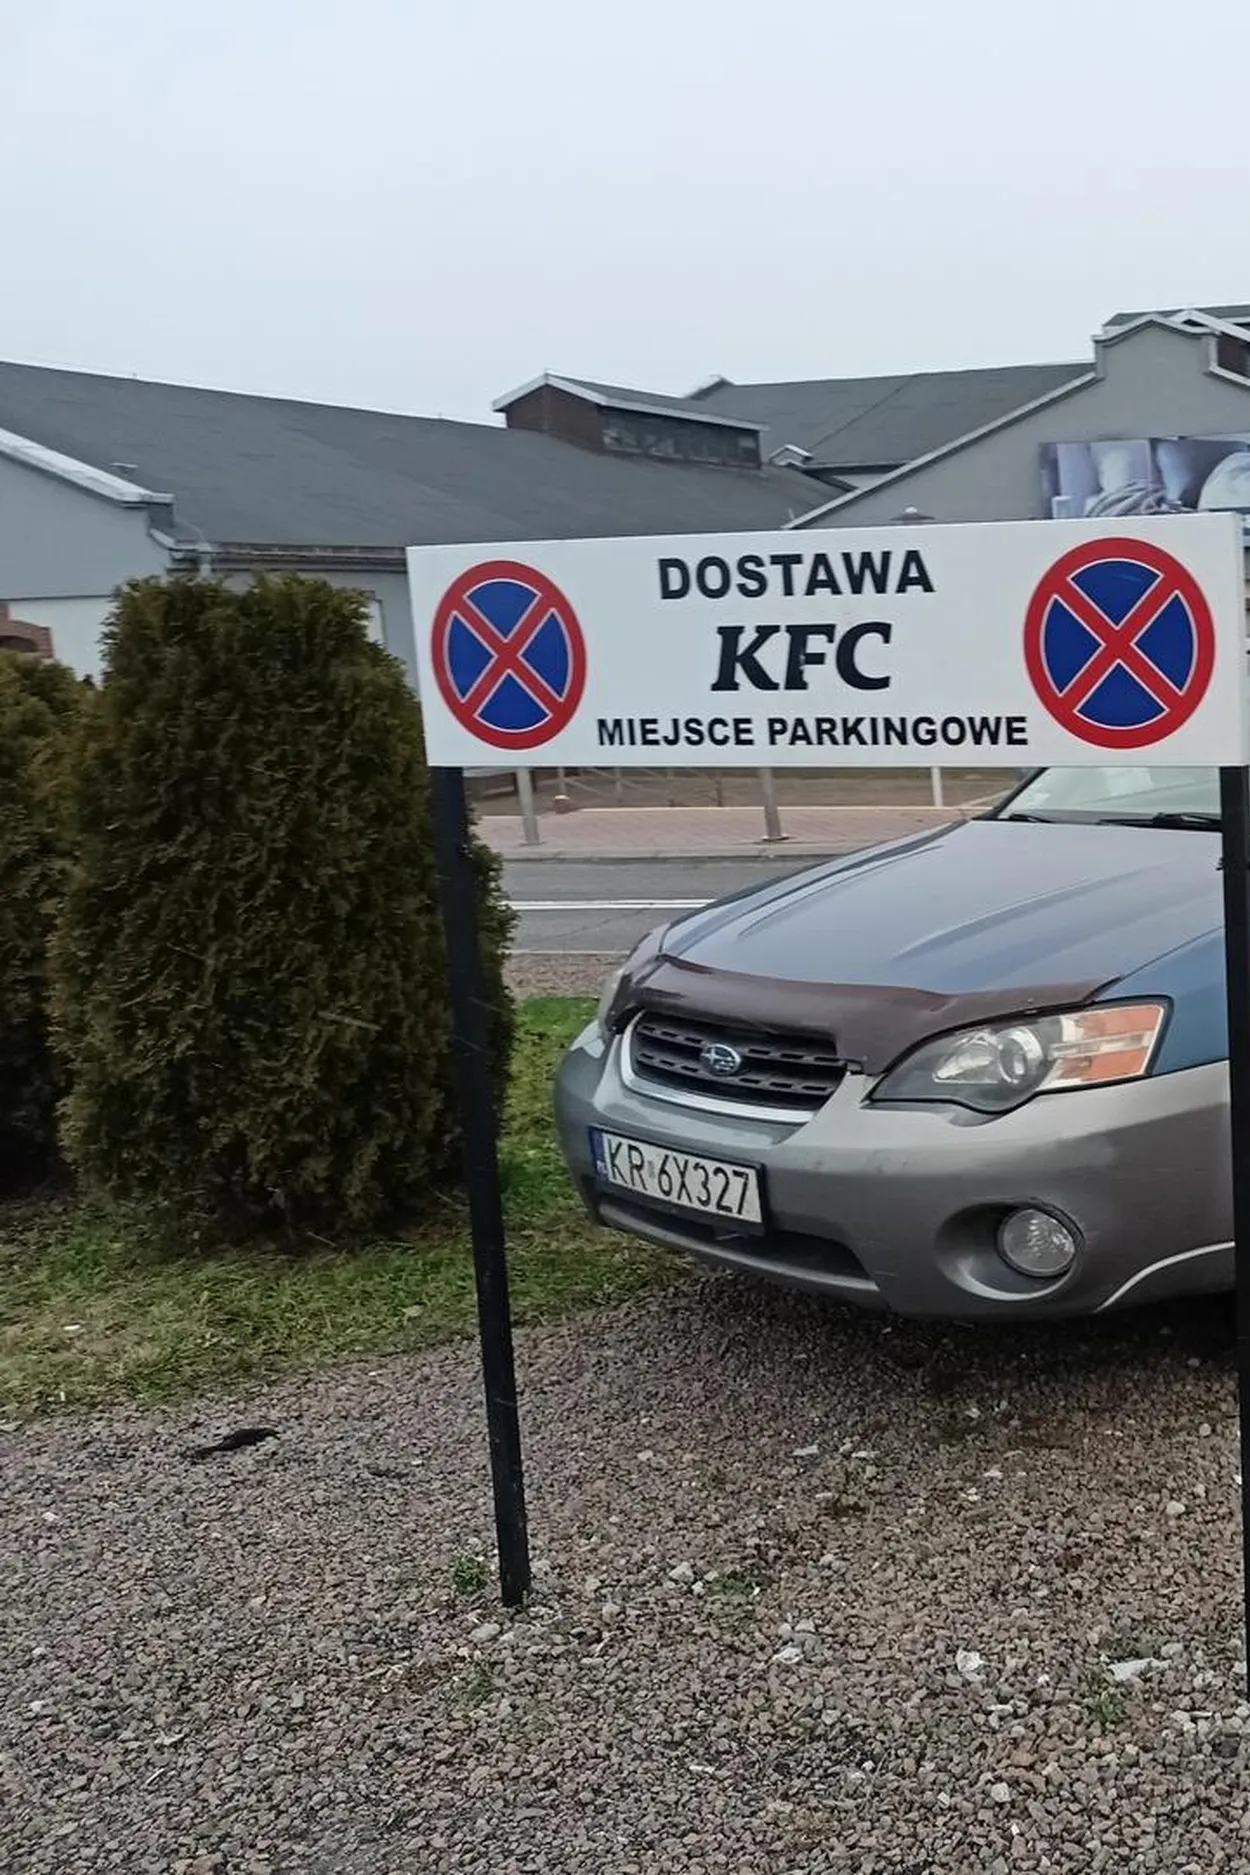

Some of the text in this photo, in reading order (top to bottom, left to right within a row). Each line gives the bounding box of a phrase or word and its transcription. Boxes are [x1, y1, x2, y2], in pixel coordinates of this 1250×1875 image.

[657, 549, 936, 600] DOSTAWA
[710, 621, 893, 692] KFC
[597, 716, 1029, 747] MIEJSCE PARKINGOWE
[608, 1139, 749, 1215] KR 6X327
